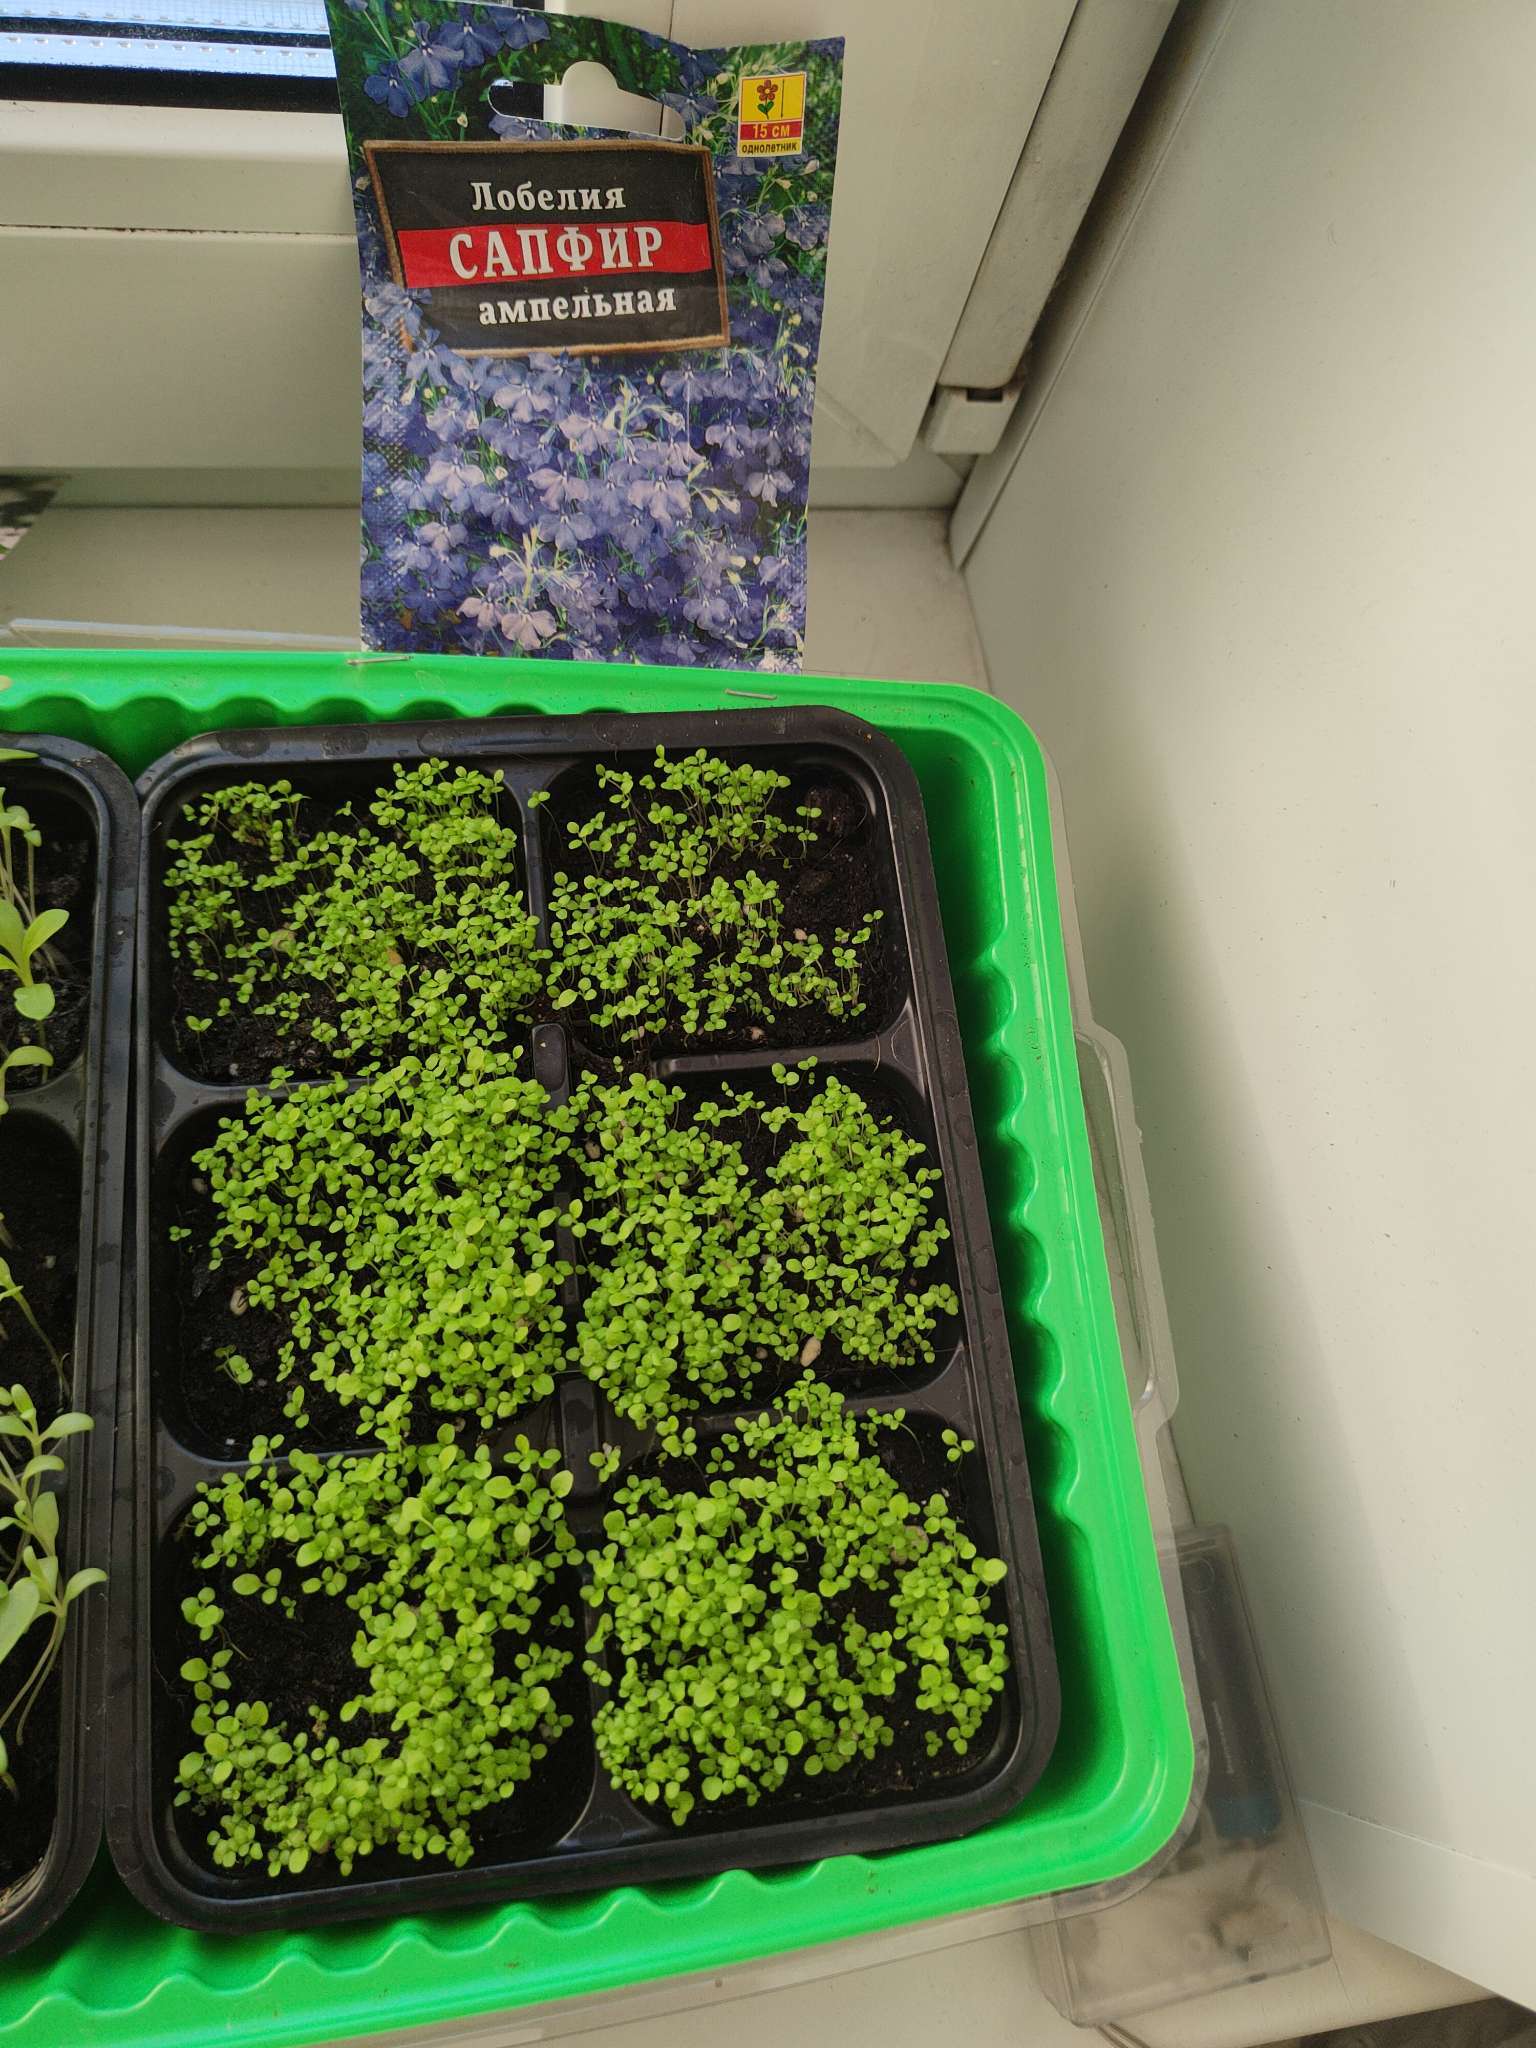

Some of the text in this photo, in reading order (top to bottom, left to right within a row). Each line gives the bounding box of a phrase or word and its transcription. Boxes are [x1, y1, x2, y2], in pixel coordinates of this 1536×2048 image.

[752, 123, 768, 139] 15
[741, 142, 797, 155] однолетник
[470, 181, 626, 212] Лобелия
[448, 226, 664, 280] САПФИР
[478, 287, 677, 326] ампельная
